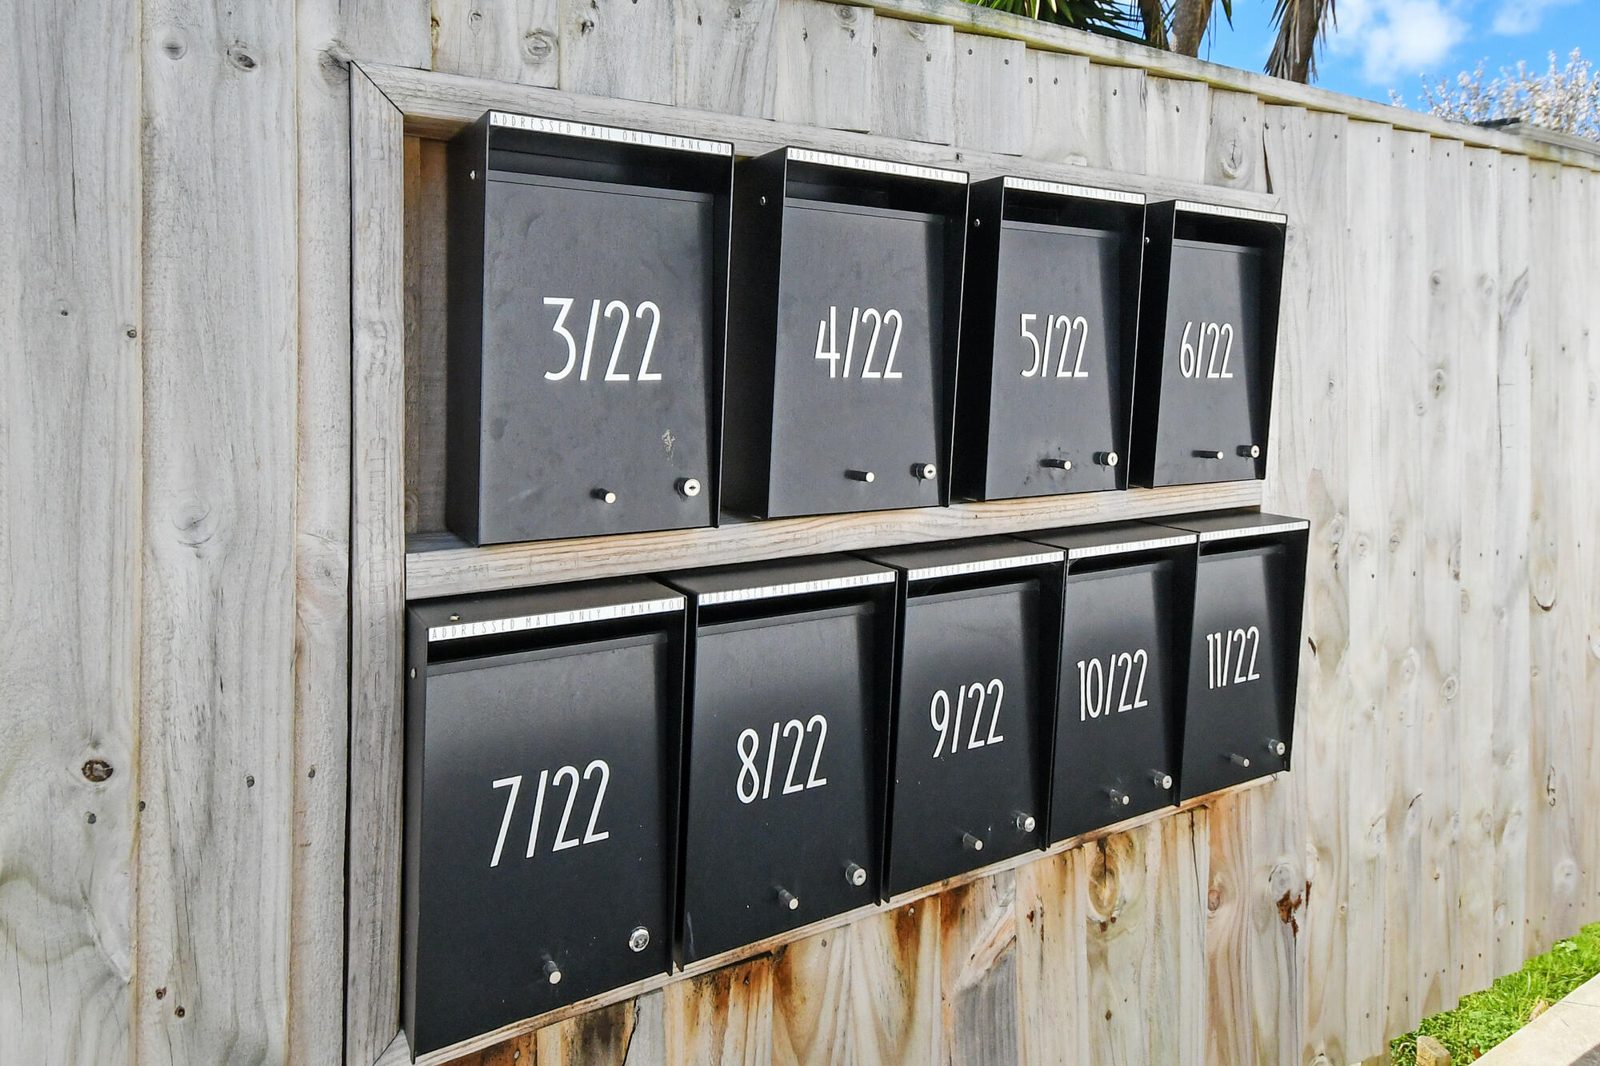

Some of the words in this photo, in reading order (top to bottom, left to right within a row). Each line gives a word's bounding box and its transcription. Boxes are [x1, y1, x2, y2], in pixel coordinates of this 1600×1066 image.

[493, 114, 571, 134] ADDRESSED
[581, 126, 611, 139] MAIL
[622, 131, 653, 144] ONLY
[663, 136, 701, 150] THANK
[709, 142, 730, 153] YOU
[544, 297, 662, 381] 3/22
[815, 306, 902, 381] 4/22
[1022, 314, 1088, 380] 5/22
[1180, 321, 1233, 379] 6/22
[432, 619, 515, 639] ADDRESSED
[525, 614, 558, 627] MAIL
[569, 608, 601, 622] ONLY
[613, 604, 651, 617] THANK
[660, 599, 682, 611] YOU
[1078, 649, 1147, 721] 10/22
[1207, 626, 1259, 689] 11/22
[931, 679, 1003, 757] 9/22
[737, 715, 827, 803] 8/22
[491, 760, 609, 867] 7/22
